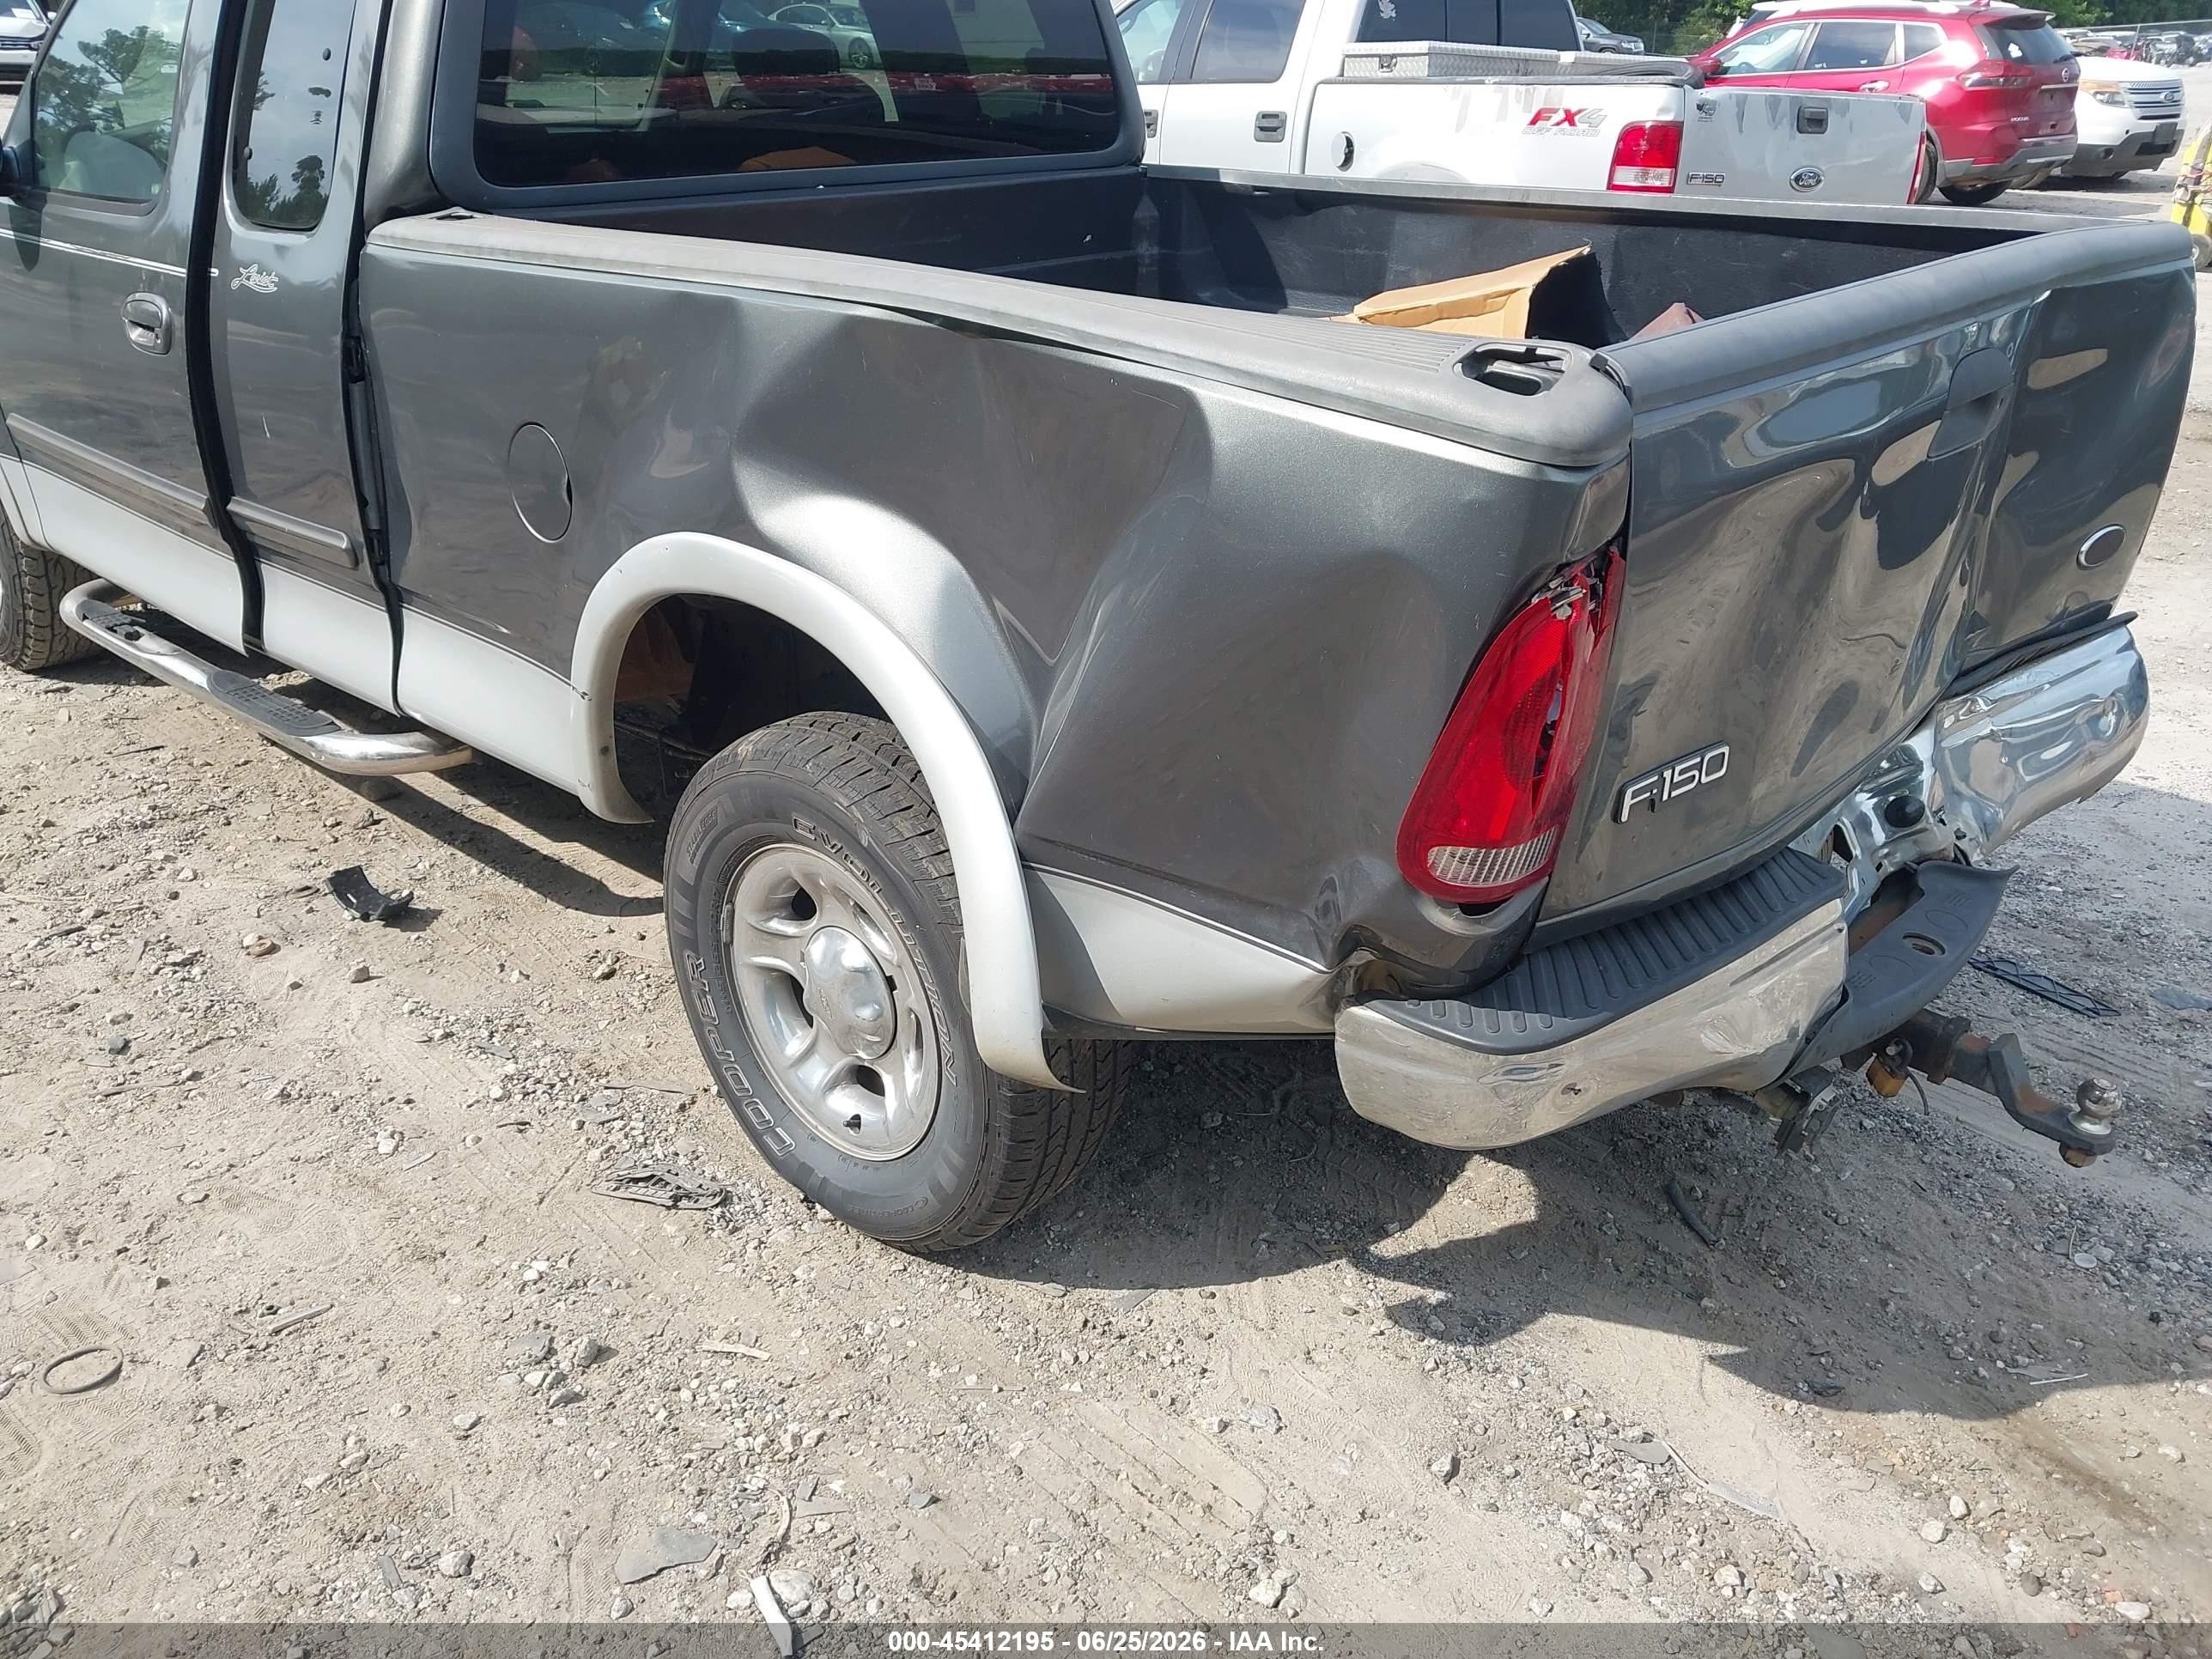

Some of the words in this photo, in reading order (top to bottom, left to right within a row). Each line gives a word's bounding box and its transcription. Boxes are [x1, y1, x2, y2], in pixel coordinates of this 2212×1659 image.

[1526, 107, 1607, 128] FX4
[1553, 127, 1601, 137] ROAD
[1798, 172, 1819, 186] Ford
[792, 816, 957, 1087] EVOLUTION
[685, 951, 796, 1157] COOPER
